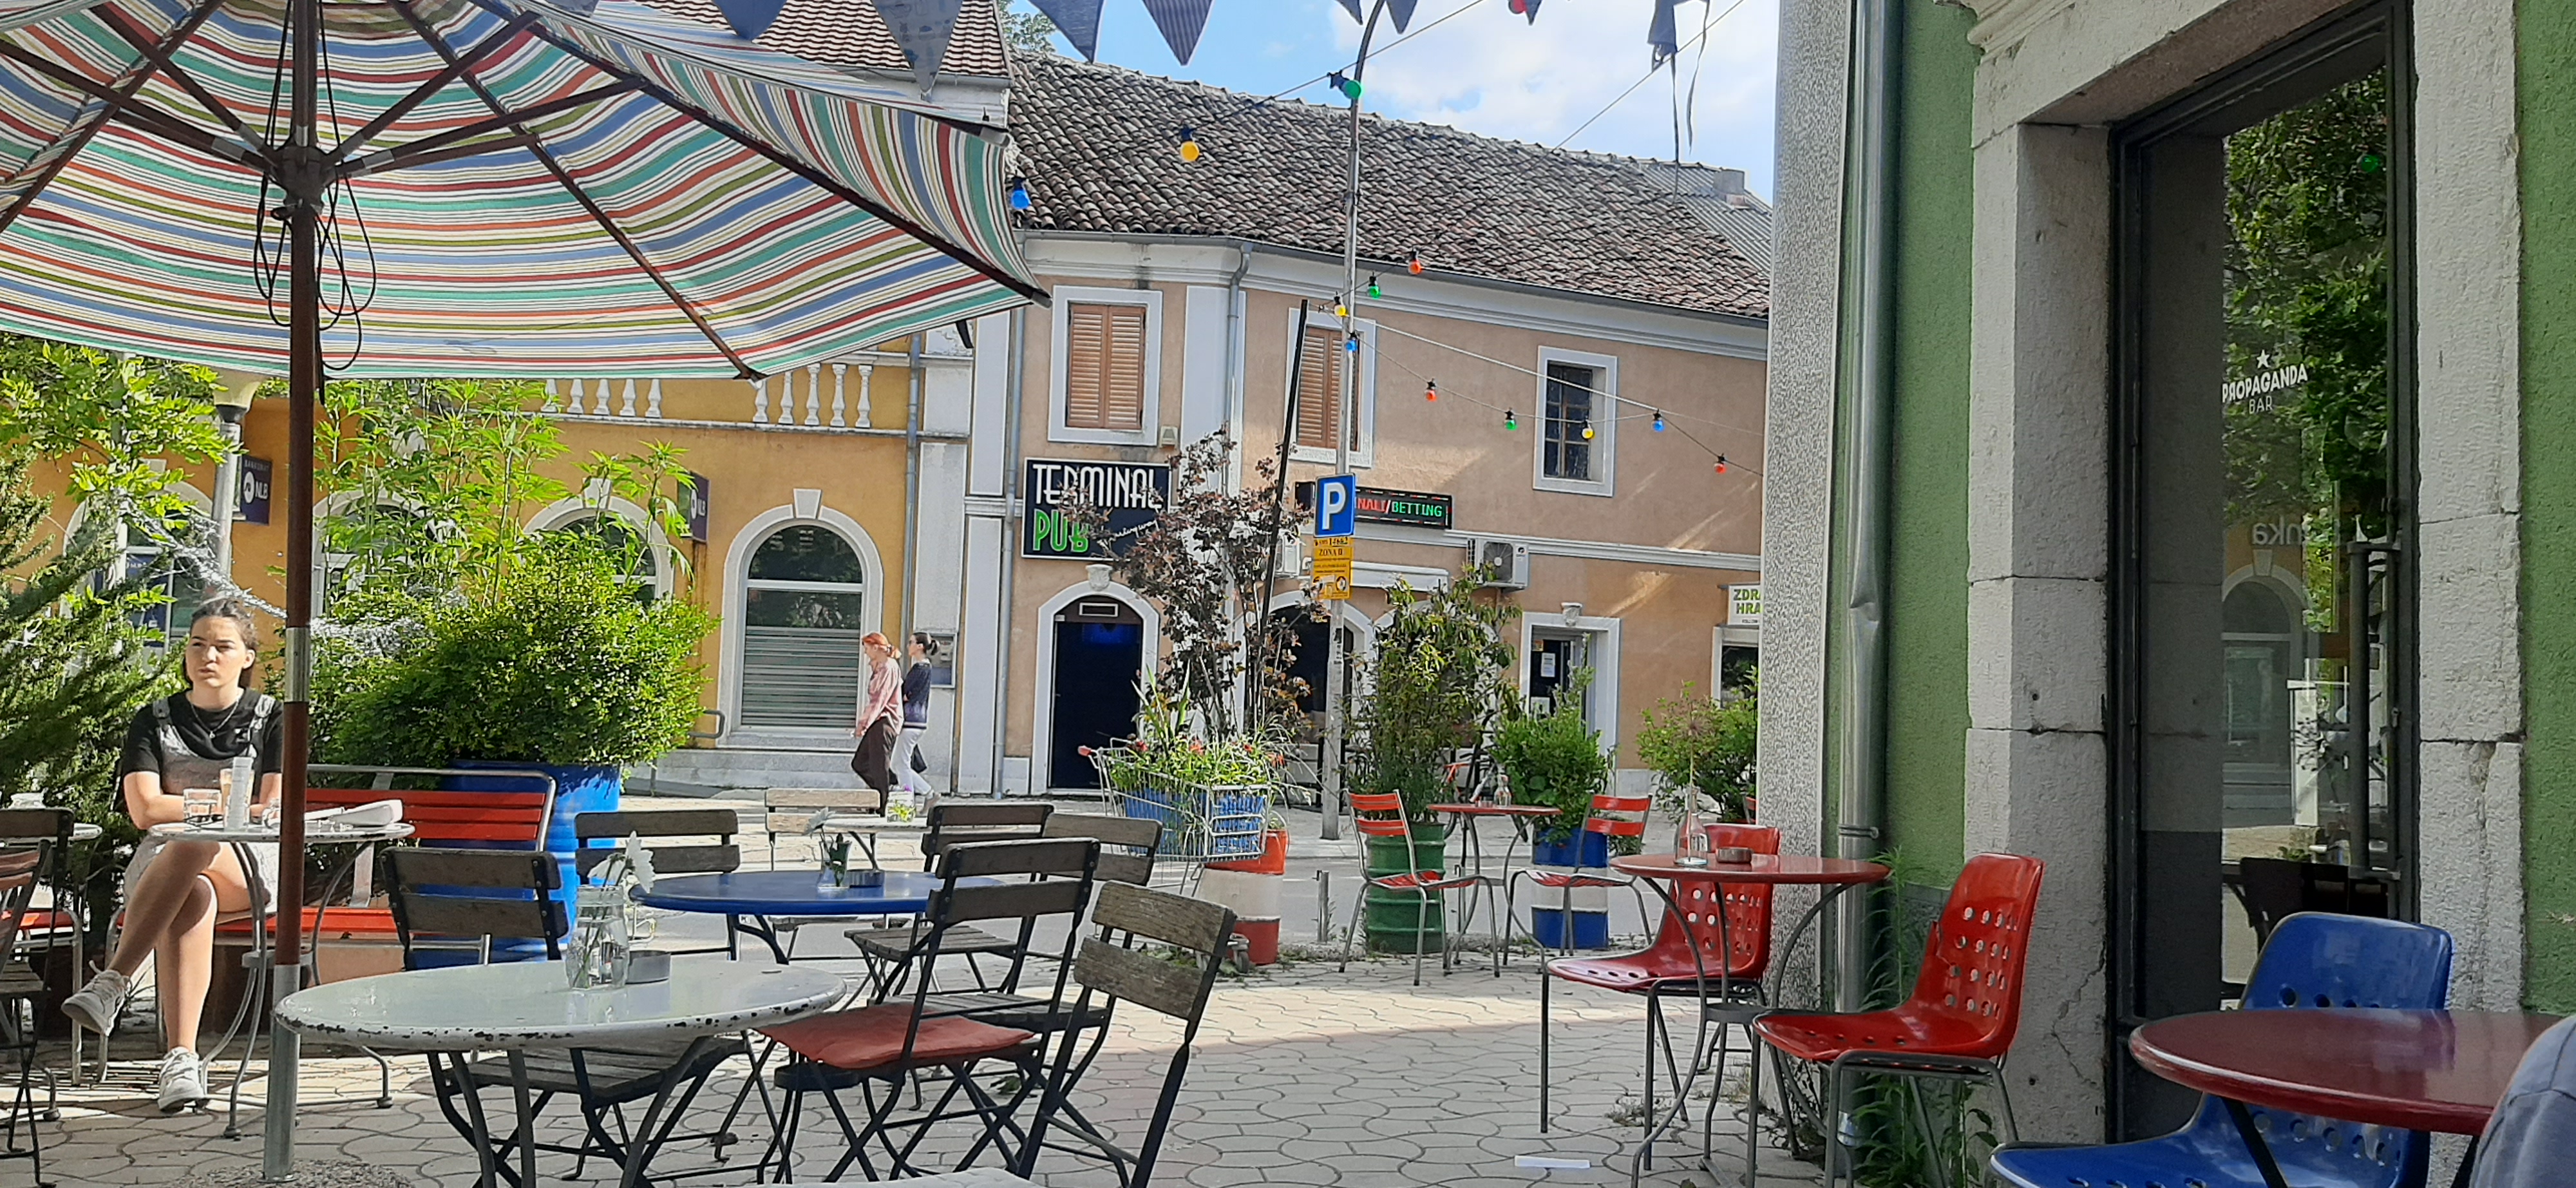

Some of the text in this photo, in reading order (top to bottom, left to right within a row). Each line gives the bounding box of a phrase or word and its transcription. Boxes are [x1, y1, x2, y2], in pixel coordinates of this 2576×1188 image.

[2222, 363, 2307, 403] PROPAGANDA
[2249, 395, 2273, 414] BAR
[255, 480, 269, 499] NLB
[1032, 464, 1162, 509] TERMINAL
[1321, 482, 1347, 530] P
[1355, 497, 1442, 517] NALI/BETTING
[1032, 508, 1088, 552] PUB
[1733, 589, 1761, 600] ZDR
